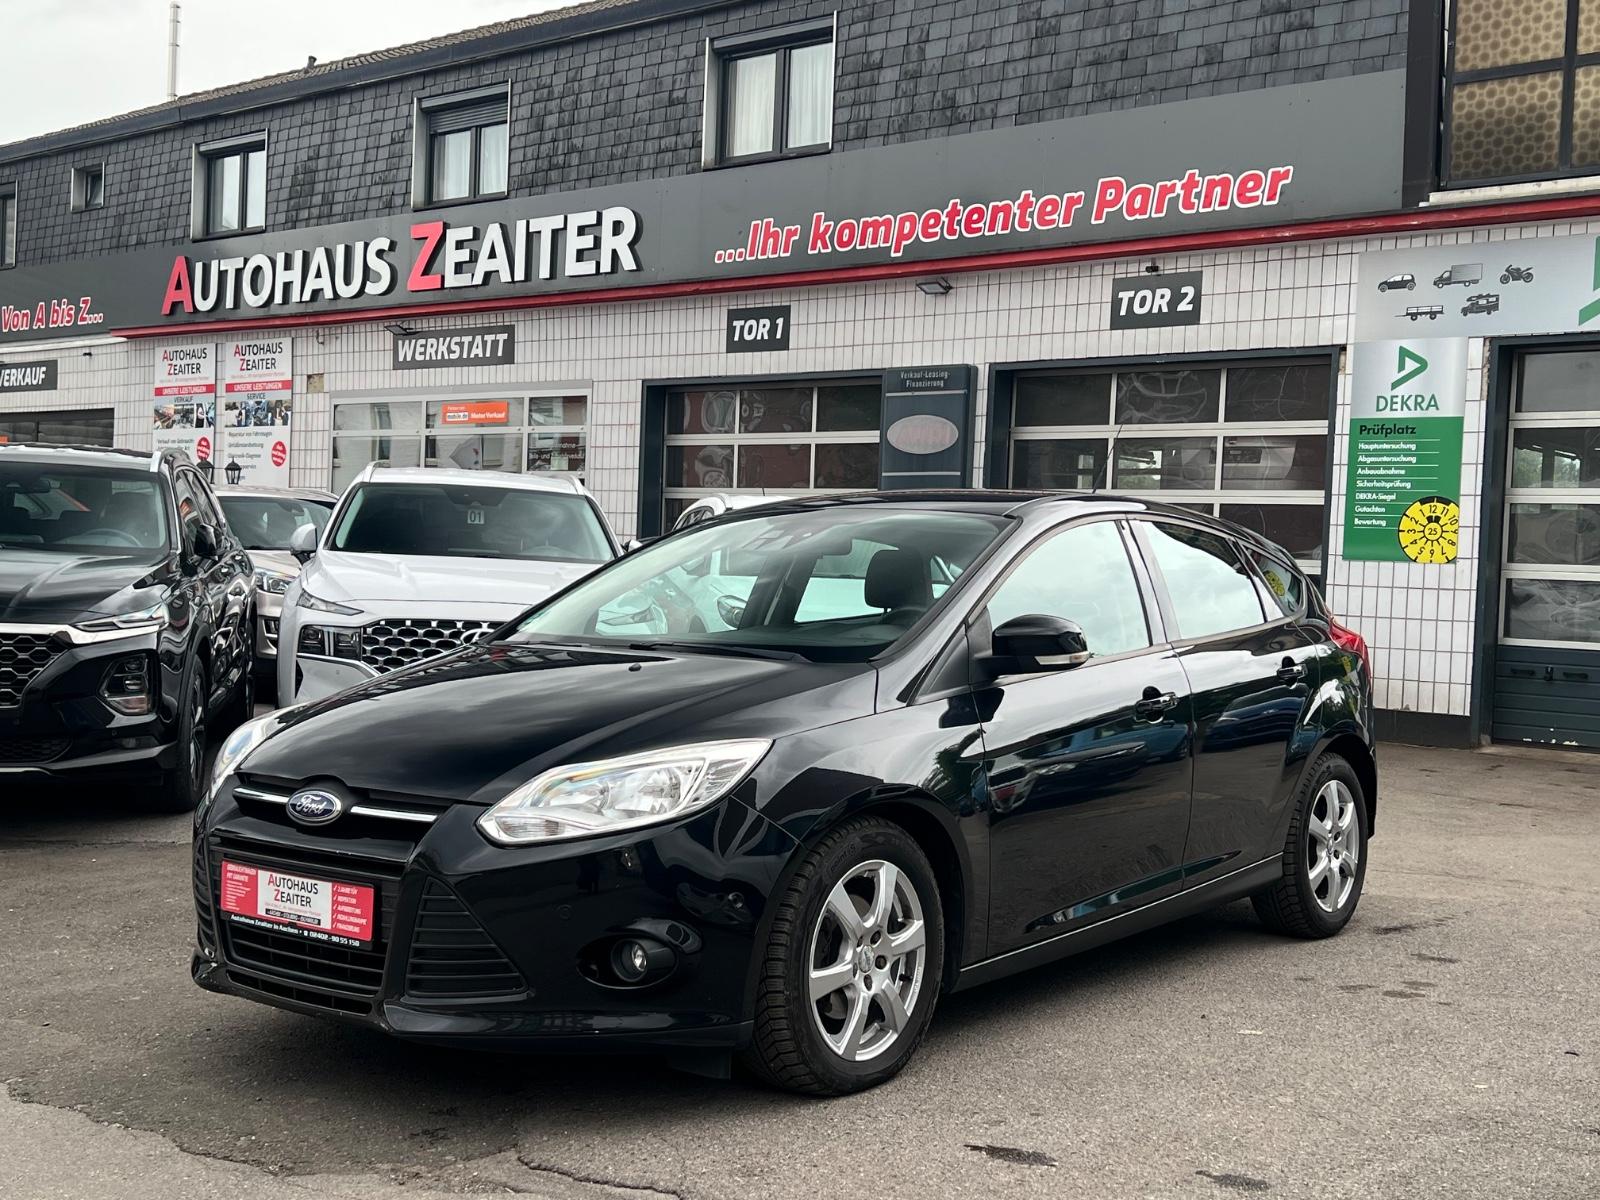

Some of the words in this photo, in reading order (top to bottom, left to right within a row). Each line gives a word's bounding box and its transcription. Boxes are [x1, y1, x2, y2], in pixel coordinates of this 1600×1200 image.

[715, 218, 800, 263] ...Ihr
[807, 191, 1084, 257] kompetenter
[1091, 165, 1293, 224] Partner
[161, 236, 394, 315] AUTOHAUS
[406, 206, 640, 291] ZEAITER
[1118, 287, 1171, 316] TOR
[1176, 285, 1195, 311] 2
[2, 305, 31, 332] Von
[33, 302, 46, 329] A
[49, 299, 75, 328] bis
[78, 297, 104, 325] Z...
[732, 318, 770, 341] TOR
[775, 317, 784, 339] 1
[234, 342, 283, 357] AUTOHAUS
[398, 333, 508, 362] WERKSTATT
[162, 347, 207, 361] AUTOHAUS
[168, 363, 201, 376] ZEAITER
[240, 358, 276, 371] ZEAITER
[906, 380, 944, 388] Finanzierung
[247, 392, 266, 400] SERVICE
[1375, 394, 1440, 412] DEKRA
[1359, 424, 1417, 437] Prüfplatz
[1358, 442, 1417, 451] Hauptuntersuchung
[1357, 454, 1417, 464] Abgasuntersuchung
[1356, 467, 1406, 475] Anbauabnahme
[1356, 480, 1411, 489] Sicherheitsprüfung
[1355, 493, 1396, 501] DEKRA-Siegel
[1355, 505, 1386, 513] Gutachten
[1429, 504, 1437, 514] 12
[1440, 507, 1449, 517] 11
[1354, 518, 1387, 526] Bewertung
[1410, 516, 1419, 525] 2
[1428, 528, 1438, 536] 25
[1417, 546, 1425, 555] 5
[295, 794, 327, 815] Ford
[268, 874, 319, 895] AUTOHAUS
[274, 889, 312, 908] ZEAITER
[230, 914, 255, 925] Autohaus
